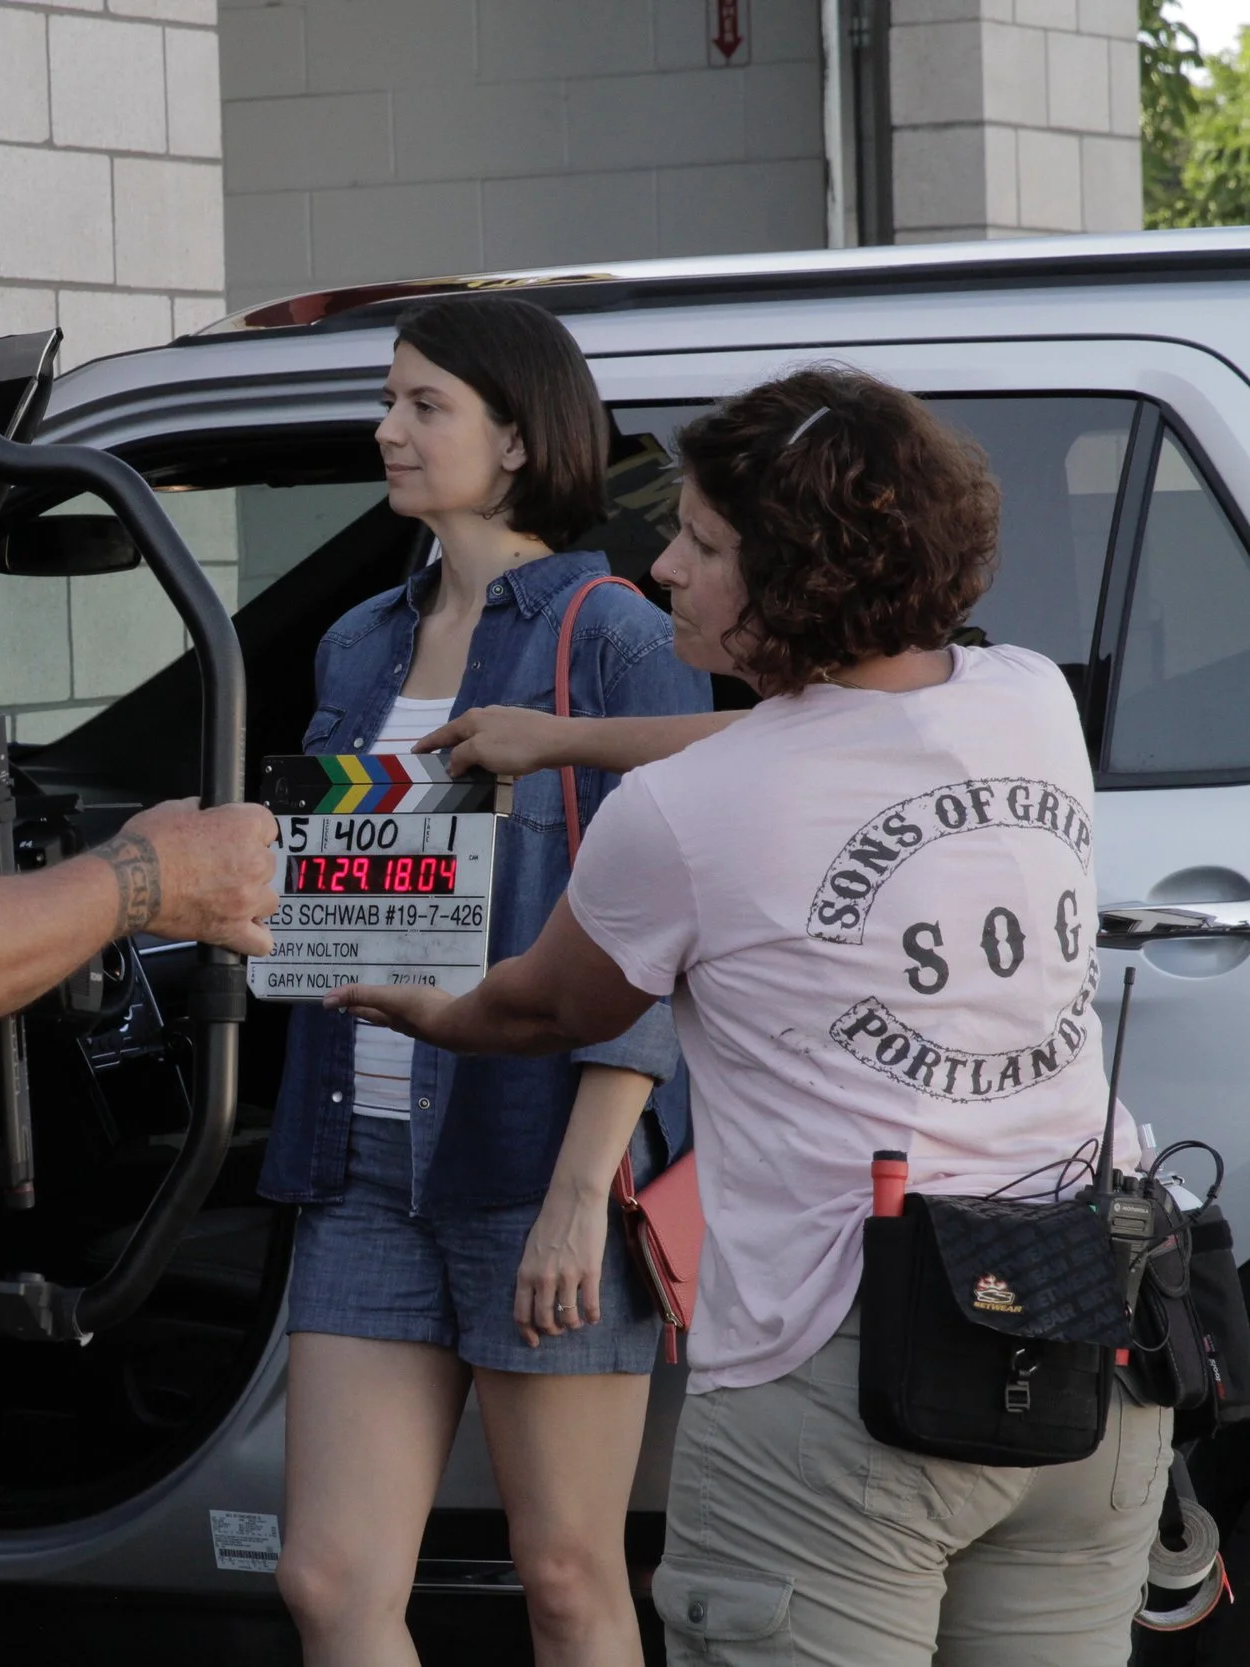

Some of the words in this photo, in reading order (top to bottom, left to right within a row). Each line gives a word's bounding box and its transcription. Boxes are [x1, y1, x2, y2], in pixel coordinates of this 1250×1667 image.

[335, 819, 399, 851] 400
[447, 815, 458, 852] 1
[817, 812, 923, 930] SONS
[934, 785, 995, 830] OF
[1006, 784, 1091, 853] GRIP
[264, 904, 293, 926] ES
[299, 904, 380, 926] SCHWAB
[269, 942, 303, 957] GARY
[307, 942, 359, 957] NOLTON
[268, 973, 303, 987] GARY
[845, 1008, 1084, 1096] PORTLAND
